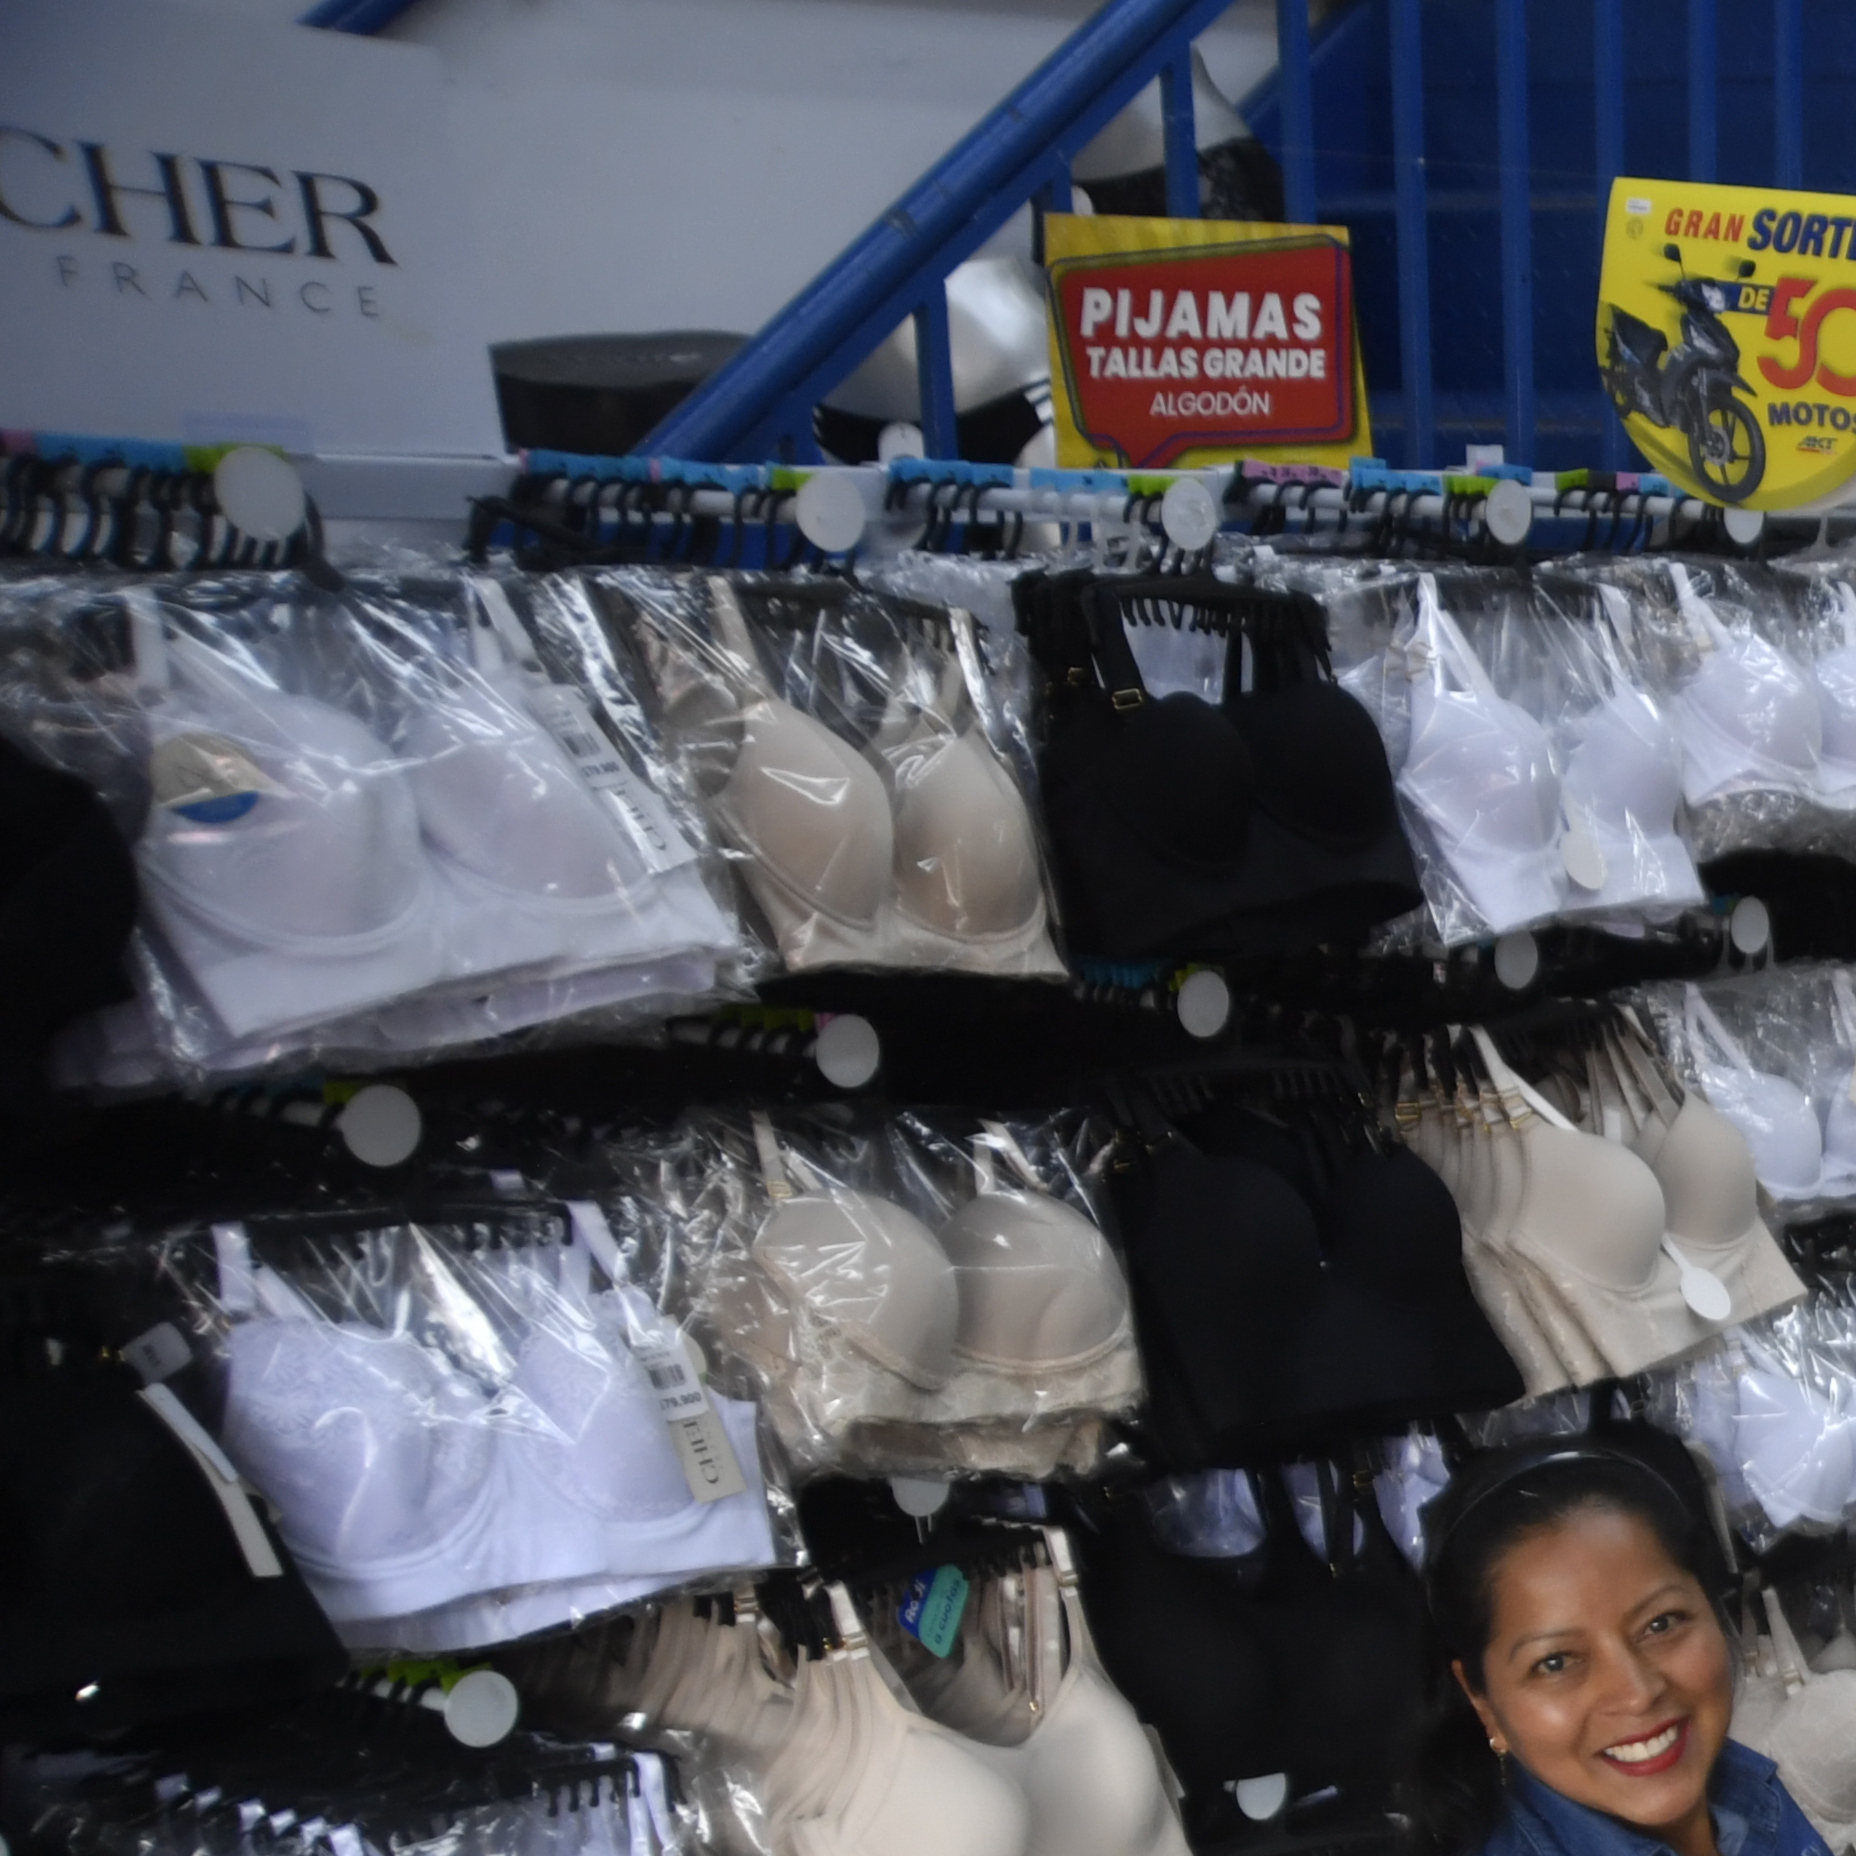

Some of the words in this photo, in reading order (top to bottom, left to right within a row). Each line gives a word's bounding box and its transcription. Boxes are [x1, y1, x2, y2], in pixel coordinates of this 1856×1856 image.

[0, 124, 398, 266] CHER
[1664, 207, 1744, 243] GRAN
[58, 255, 381, 318] FRANCE
[1738, 287, 1771, 313] DE
[1080, 286, 1323, 341] PIJAMAS
[1087, 346, 1199, 380] TALLAS
[1203, 348, 1326, 379] GRANDE
[1149, 385, 1272, 417] ALGODÓN
